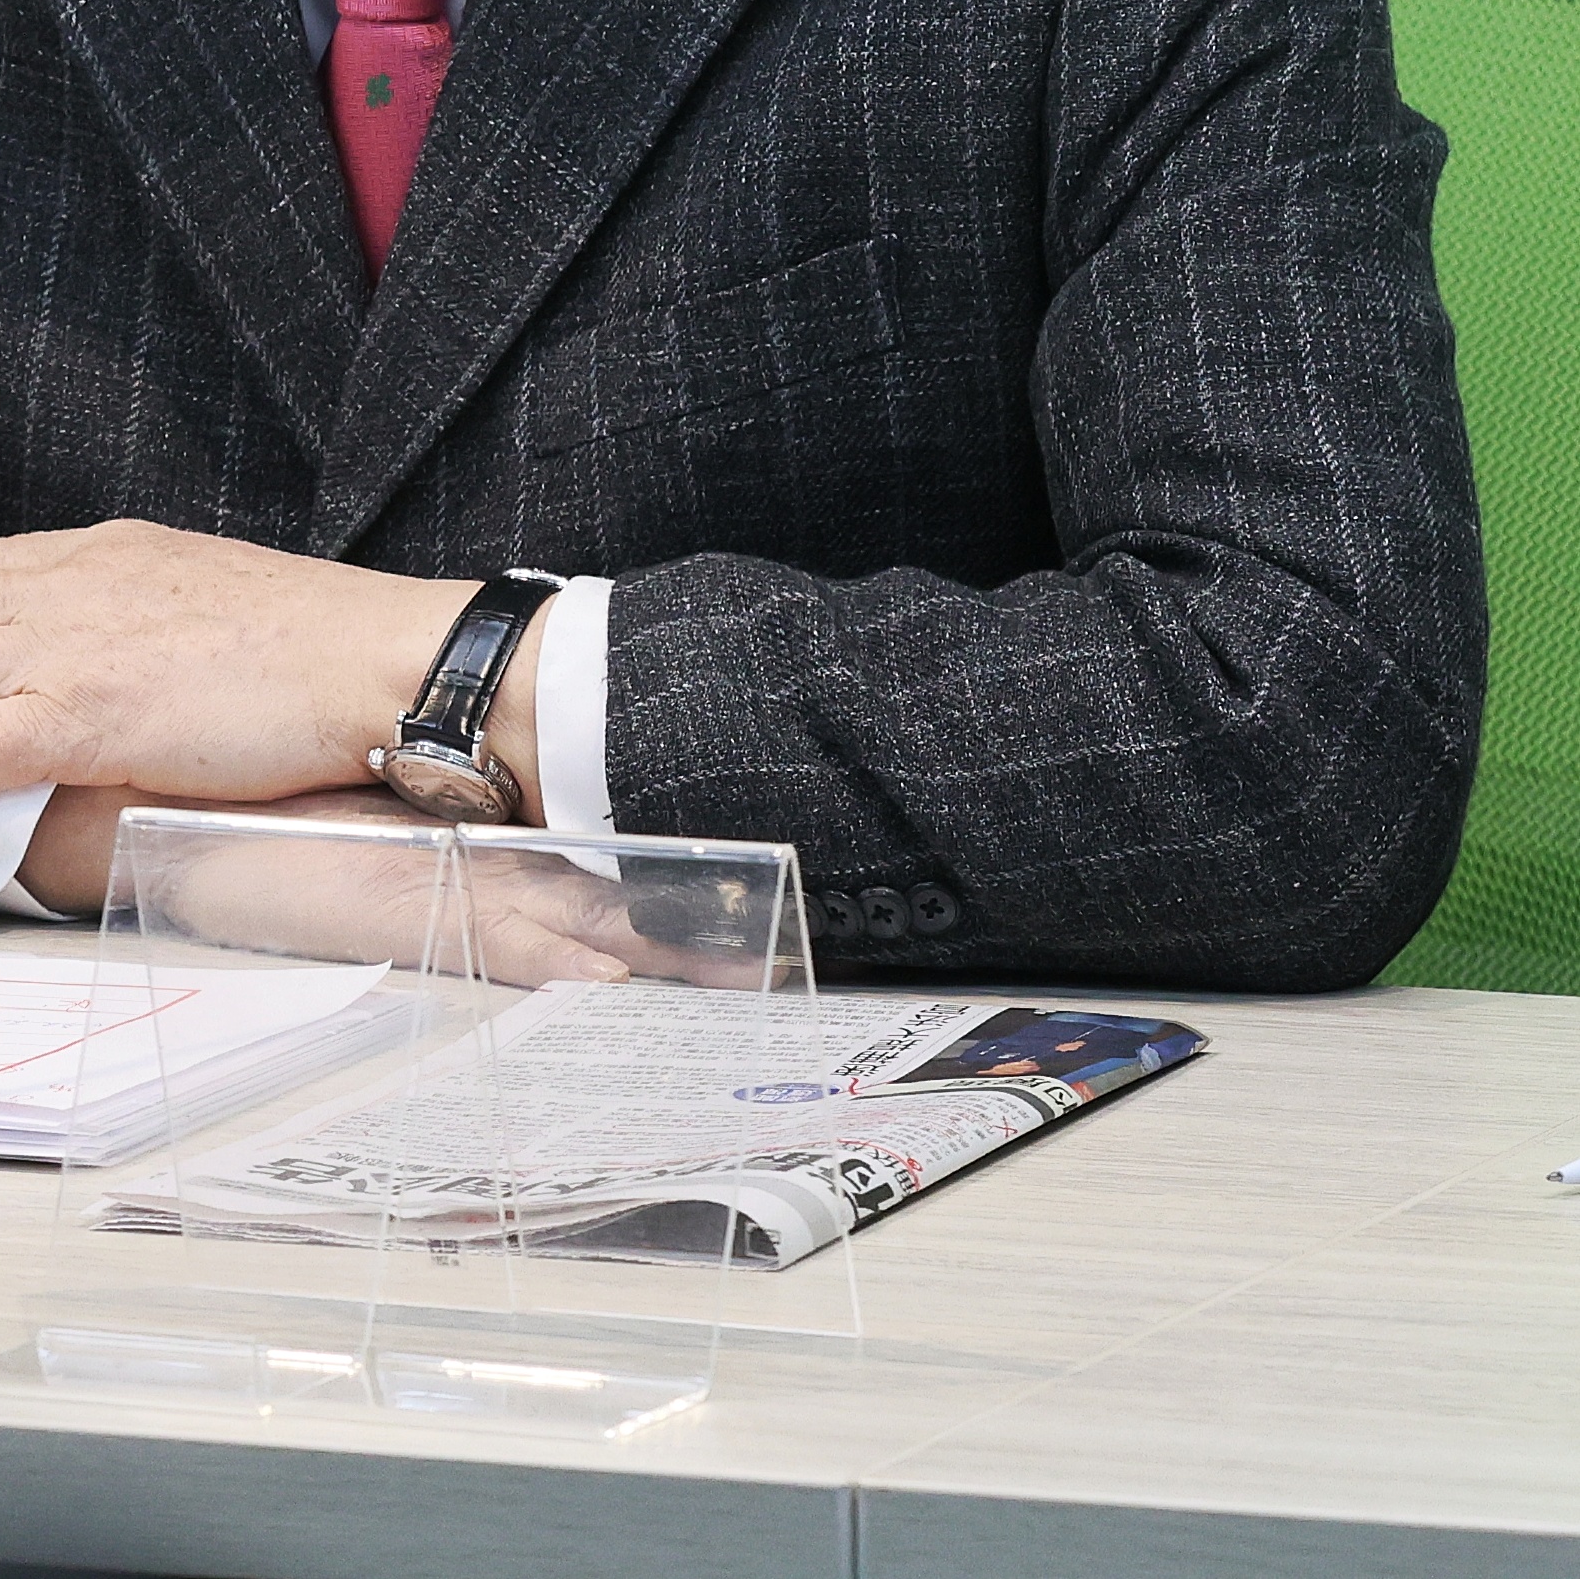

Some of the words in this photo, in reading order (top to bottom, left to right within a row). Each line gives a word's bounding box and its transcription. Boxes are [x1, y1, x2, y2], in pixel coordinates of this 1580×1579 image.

[830, 1003, 972, 1077] 速補提大法官
